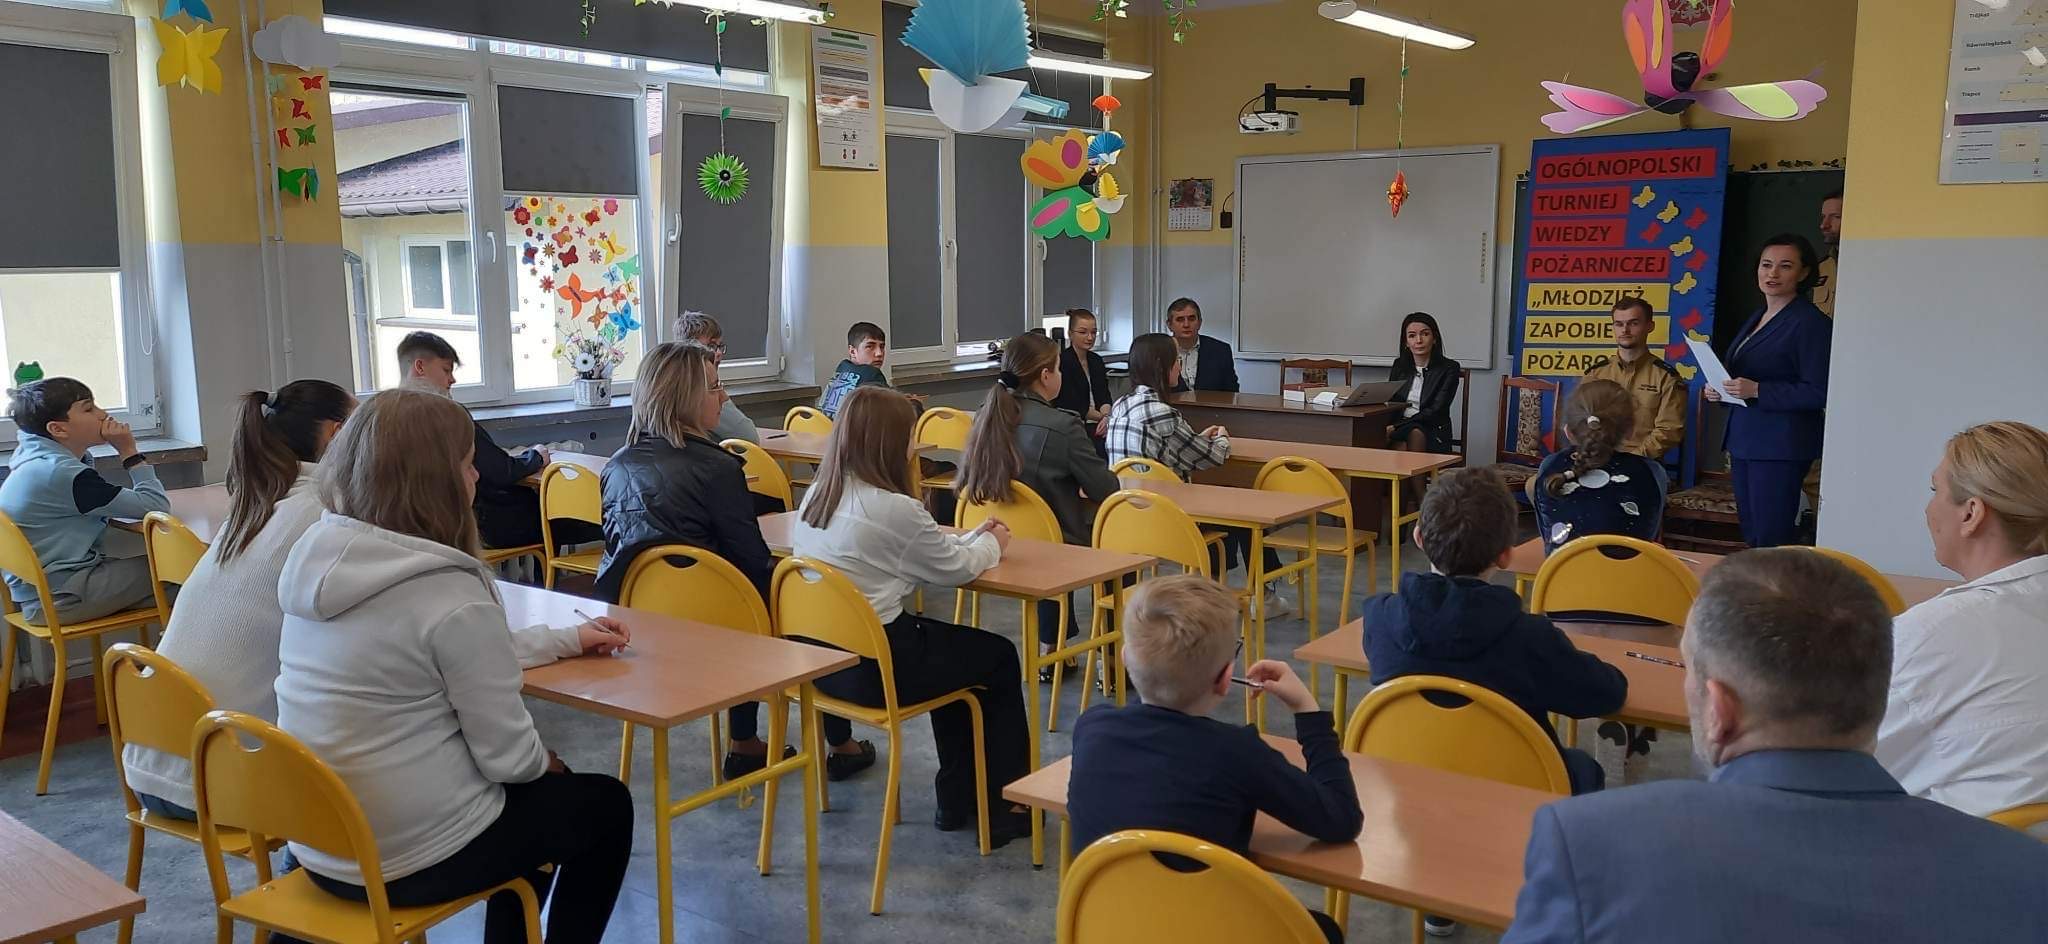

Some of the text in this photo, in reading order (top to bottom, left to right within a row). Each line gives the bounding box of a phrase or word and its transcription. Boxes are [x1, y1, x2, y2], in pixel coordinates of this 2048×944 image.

[1541, 155, 1701, 178] OGÓLNOPOLSKI
[1537, 193, 1618, 211] TURNIEJ
[1536, 226, 1612, 242] WIEDZY
[1532, 252, 1666, 274] POŻARNICZEJ
[1530, 322, 1614, 338] ZAPOBIE
[1527, 351, 1616, 370] POŻARO
